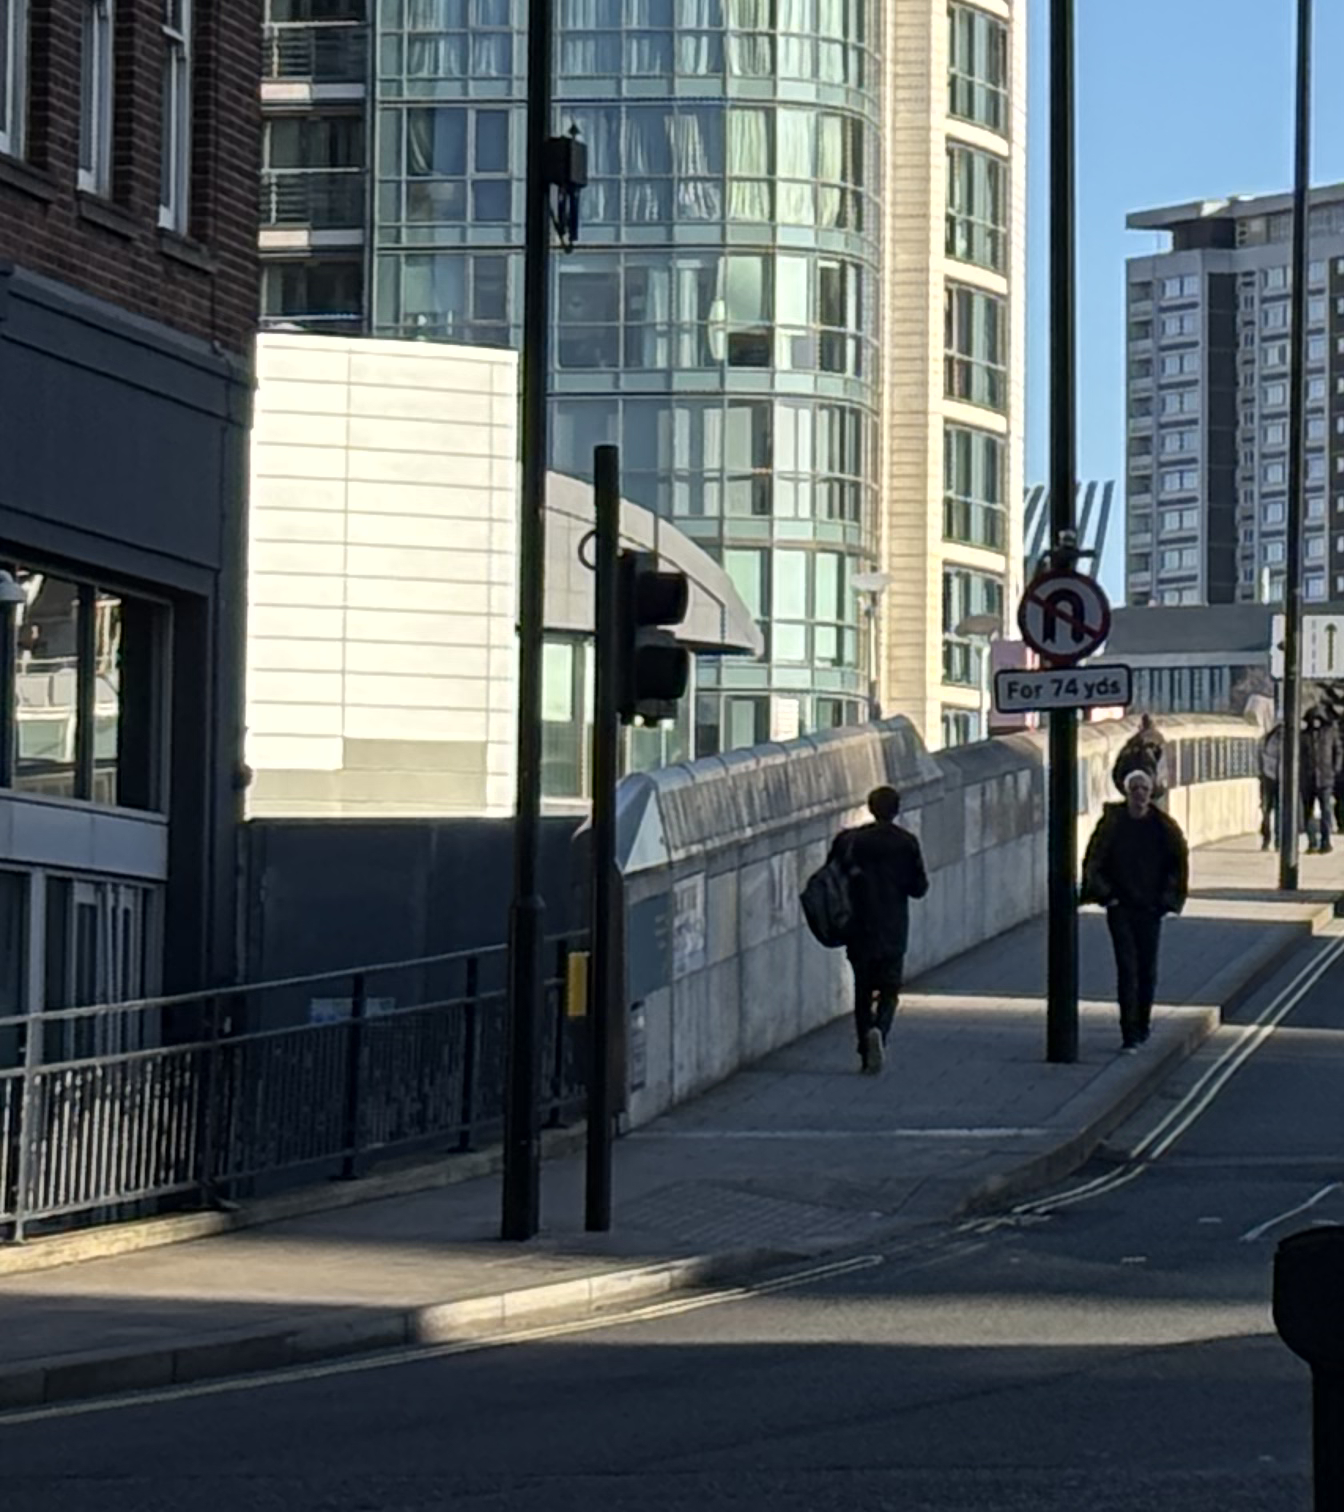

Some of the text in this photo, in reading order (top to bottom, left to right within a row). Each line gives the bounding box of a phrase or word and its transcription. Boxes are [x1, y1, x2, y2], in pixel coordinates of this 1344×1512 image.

[1007, 676, 1122, 701] For 74 yds
